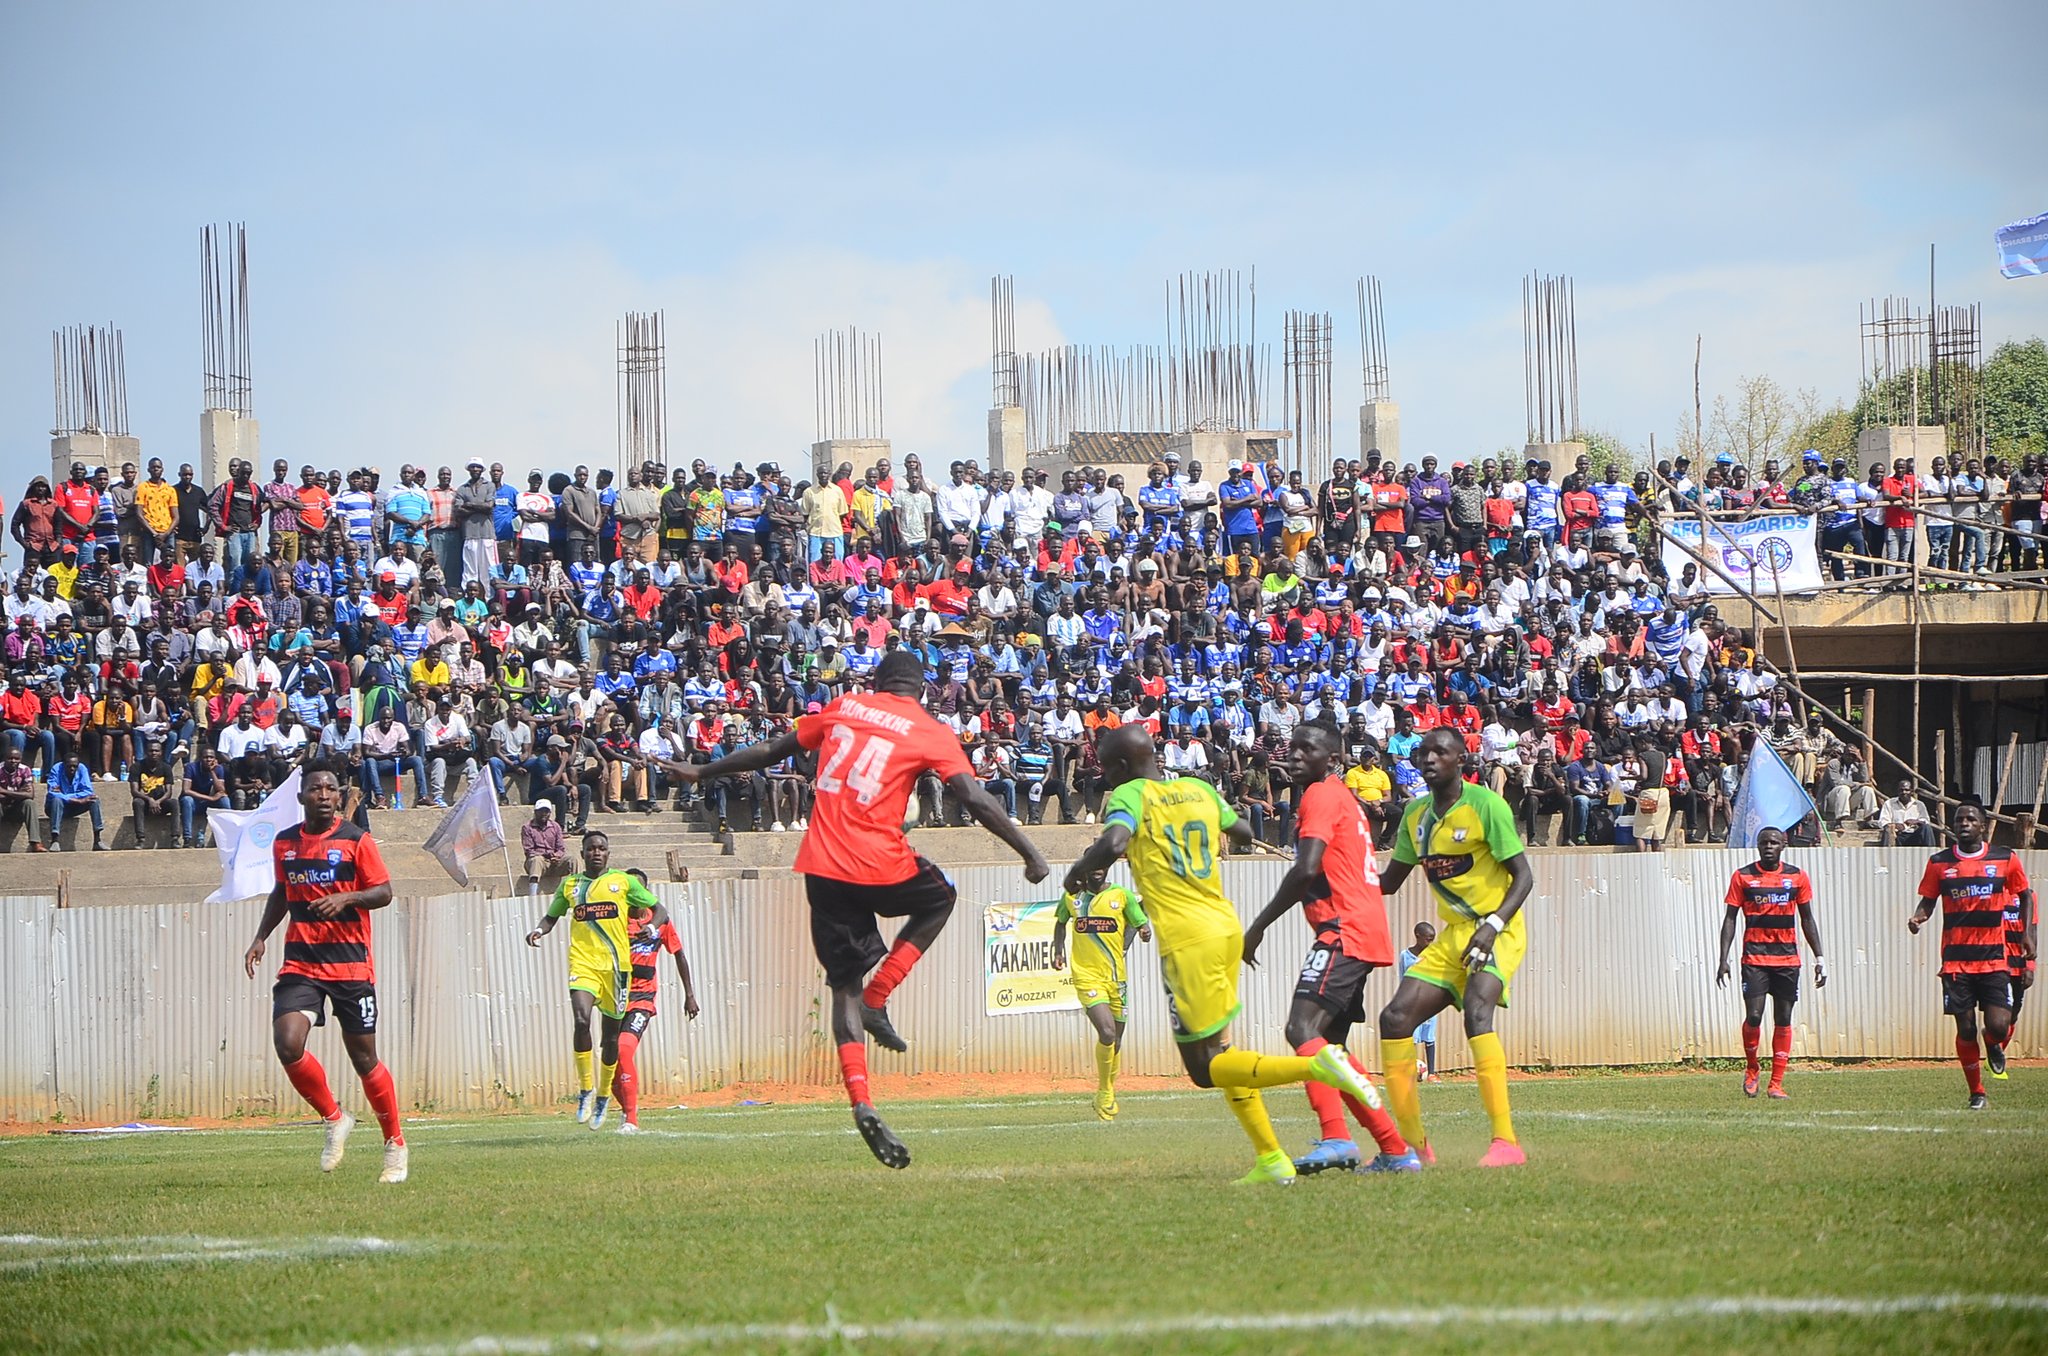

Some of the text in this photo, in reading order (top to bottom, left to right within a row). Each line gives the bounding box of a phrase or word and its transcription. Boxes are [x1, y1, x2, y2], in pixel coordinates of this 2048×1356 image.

[1709, 515, 1809, 536] LEOPARDS
[837, 698, 915, 736] MUKHEKHE
[817, 723, 896, 806] 24
[1164, 820, 1212, 879] 10
[1951, 883, 1994, 899] Betika!
[1303, 949, 1330, 971] 28
[359, 996, 375, 1017] 15
[1015, 991, 1057, 1001] MOZZART
